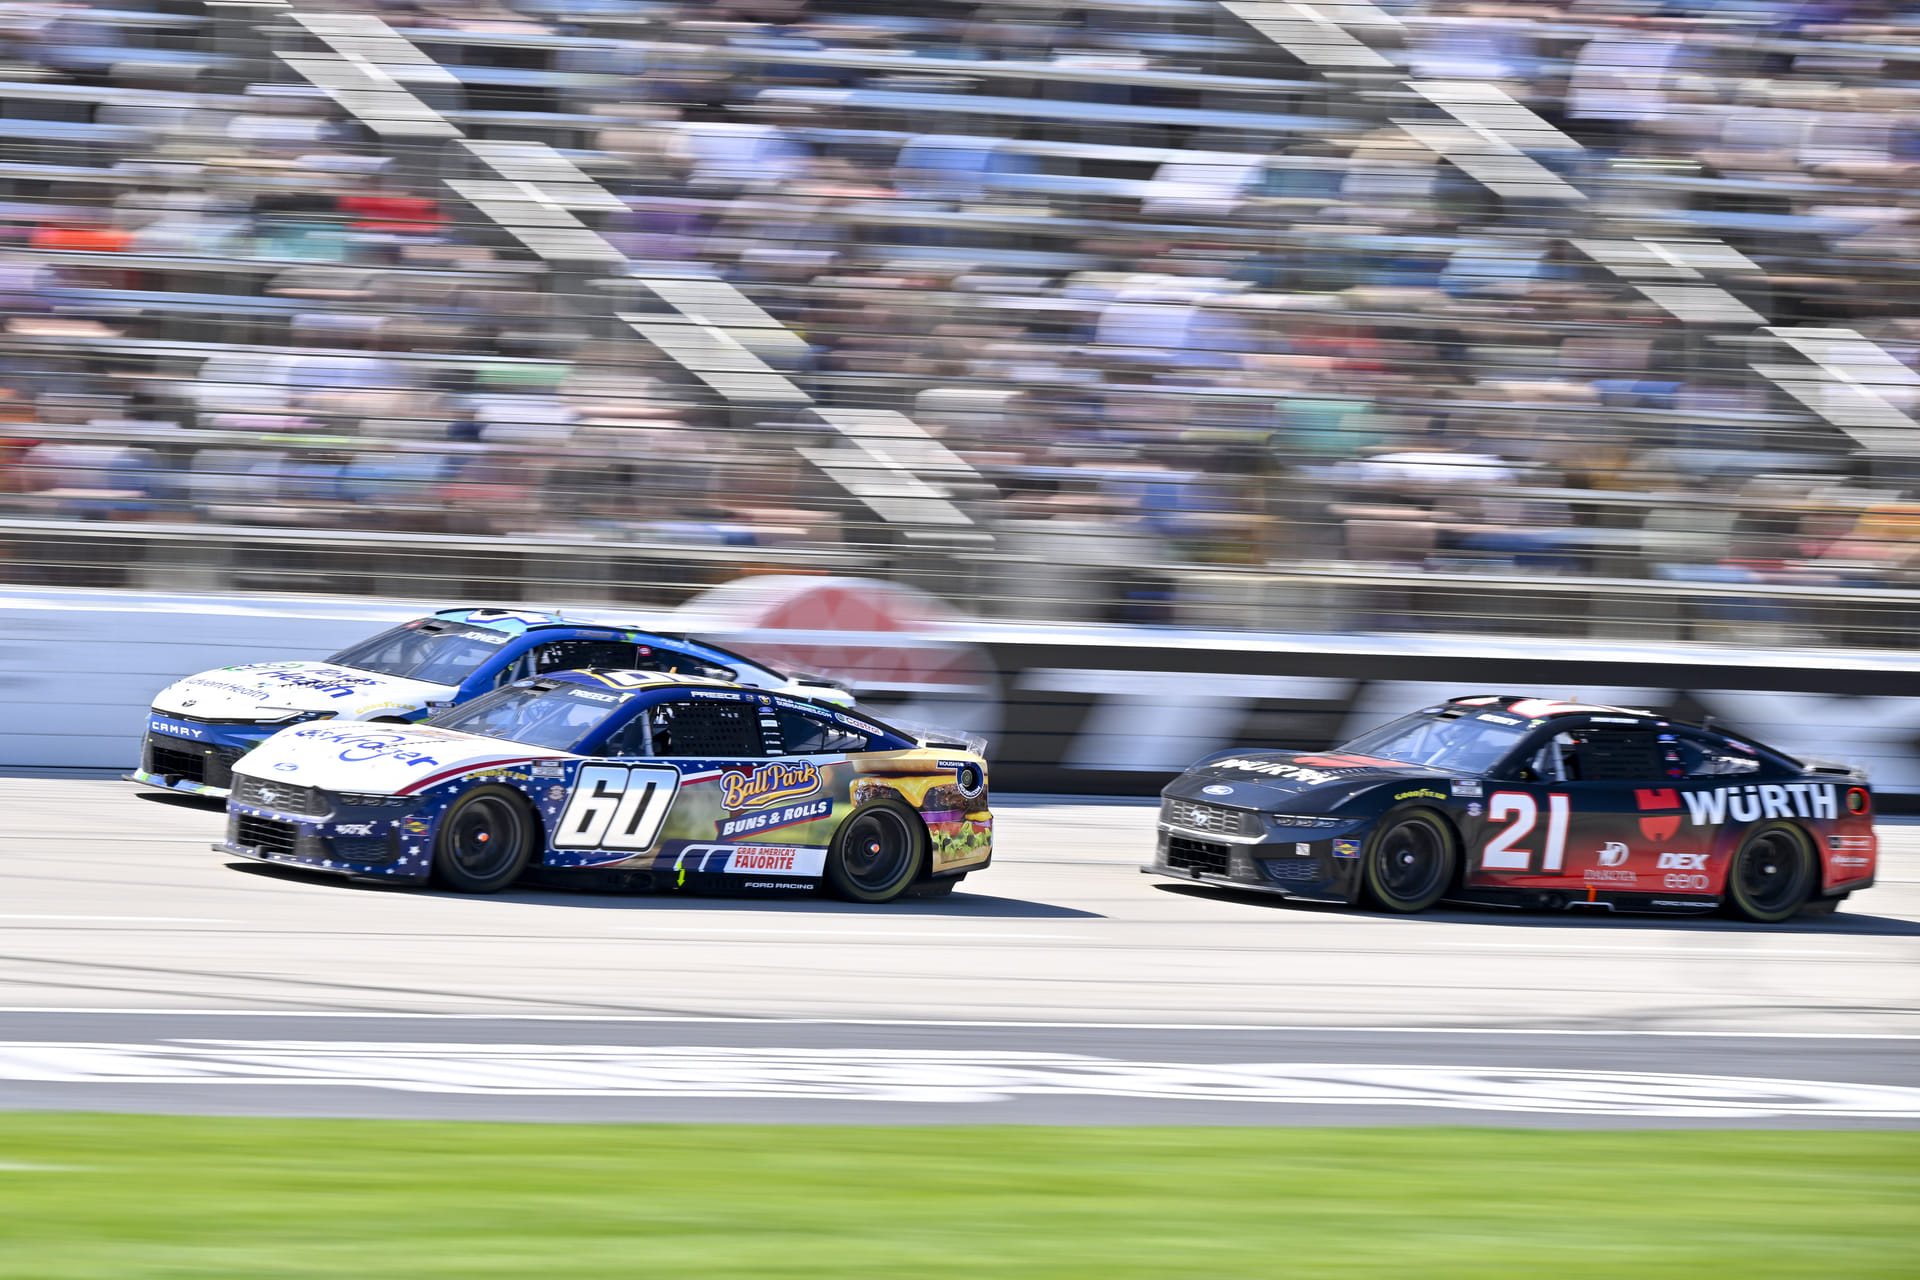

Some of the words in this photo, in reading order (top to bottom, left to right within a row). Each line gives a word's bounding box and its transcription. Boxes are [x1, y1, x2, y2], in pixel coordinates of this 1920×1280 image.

[690, 690, 741, 701] PREECE
[555, 761, 681, 853] 60
[722, 771, 771, 809] Ball
[1680, 783, 1839, 826] WÜRTH
[722, 814, 768, 836] BUNS
[769, 812, 780, 825] &
[783, 801, 828, 821] ROLLS
[1480, 790, 1571, 875] 21
[734, 855, 795, 870] FAVORITE
[737, 847, 757, 855] GRAB
[758, 848, 796, 857] AMERICA'S
[1655, 852, 1712, 871] DEX
